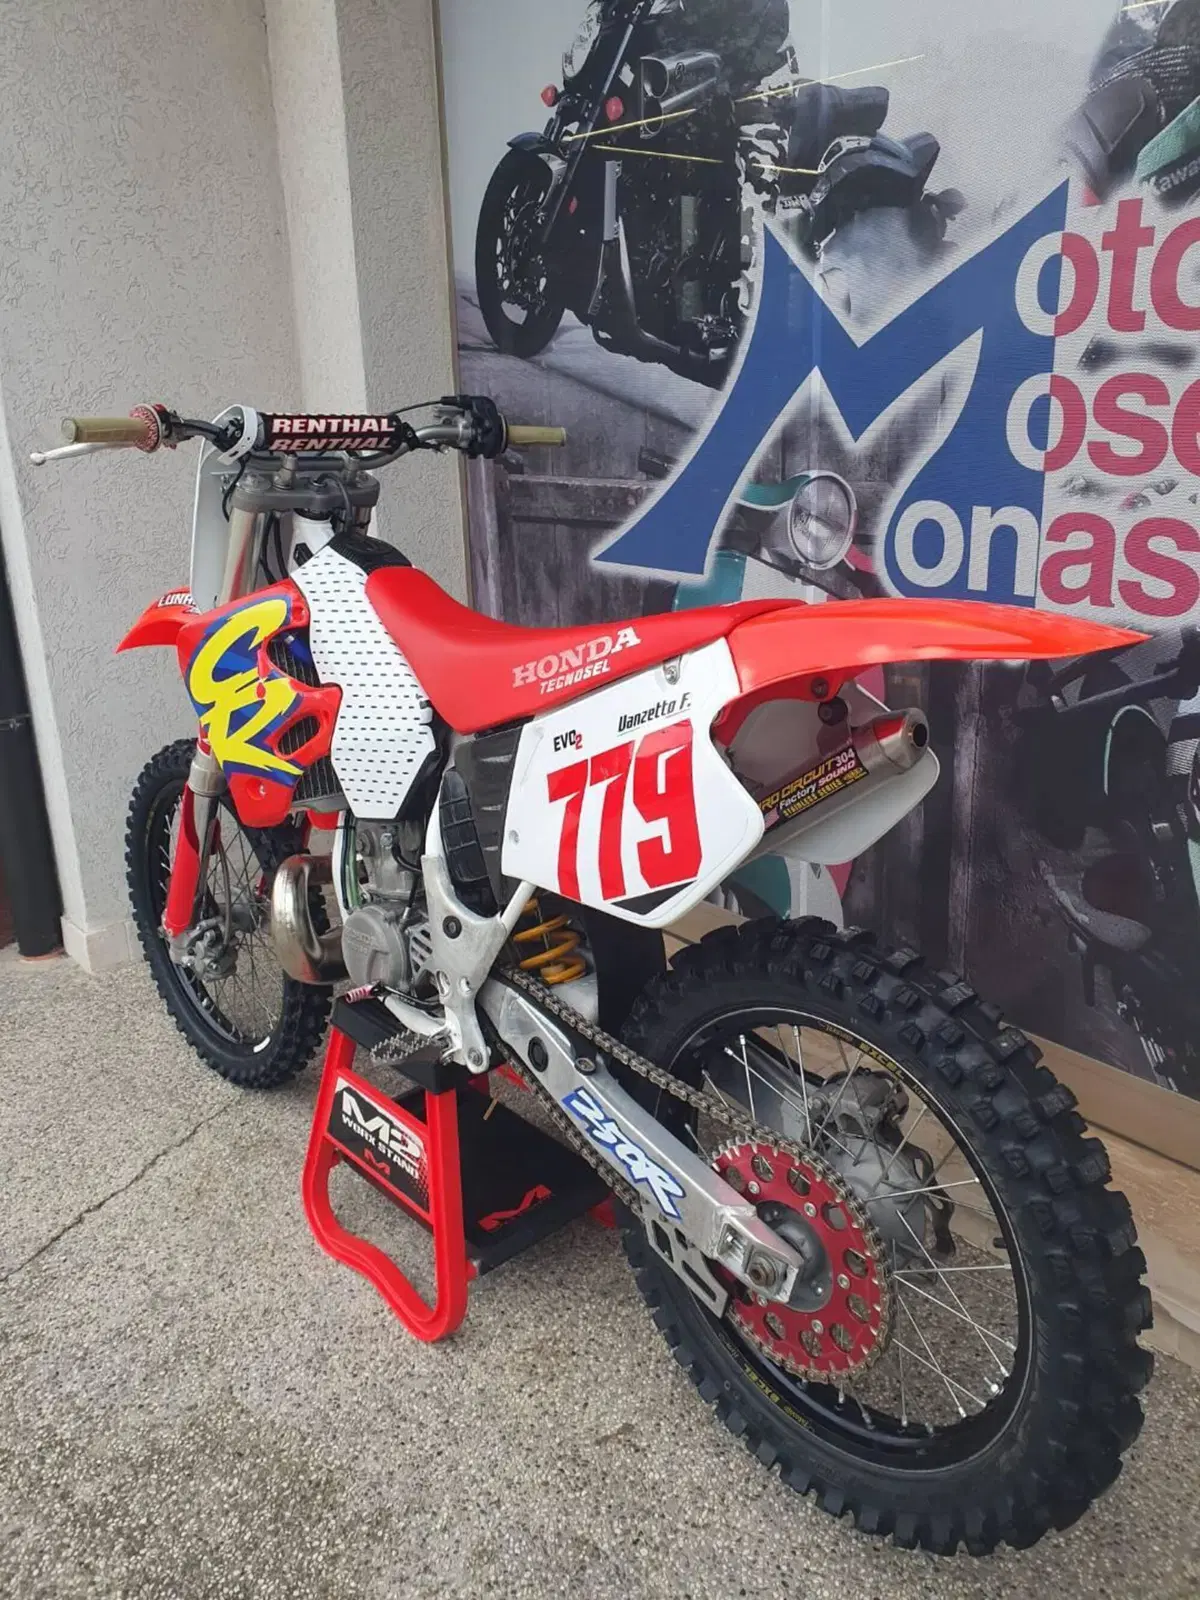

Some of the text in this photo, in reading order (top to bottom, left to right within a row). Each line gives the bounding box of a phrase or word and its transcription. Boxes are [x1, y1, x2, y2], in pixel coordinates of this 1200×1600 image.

[268, 437, 392, 451] RENTHAL
[271, 418, 396, 433] RENTHAL
[513, 626, 641, 688] HONDA
[540, 659, 611, 695] TECNOSEL
[759, 792, 780, 811] RO
[781, 759, 834, 798] CIRCUIT
[835, 748, 855, 767] 304
[780, 783, 817, 809] Factory
[818, 760, 855, 786] SOUND
[547, 718, 703, 902] 779
[378, 1141, 419, 1179] STAND
[563, 1087, 686, 1218] 250R
